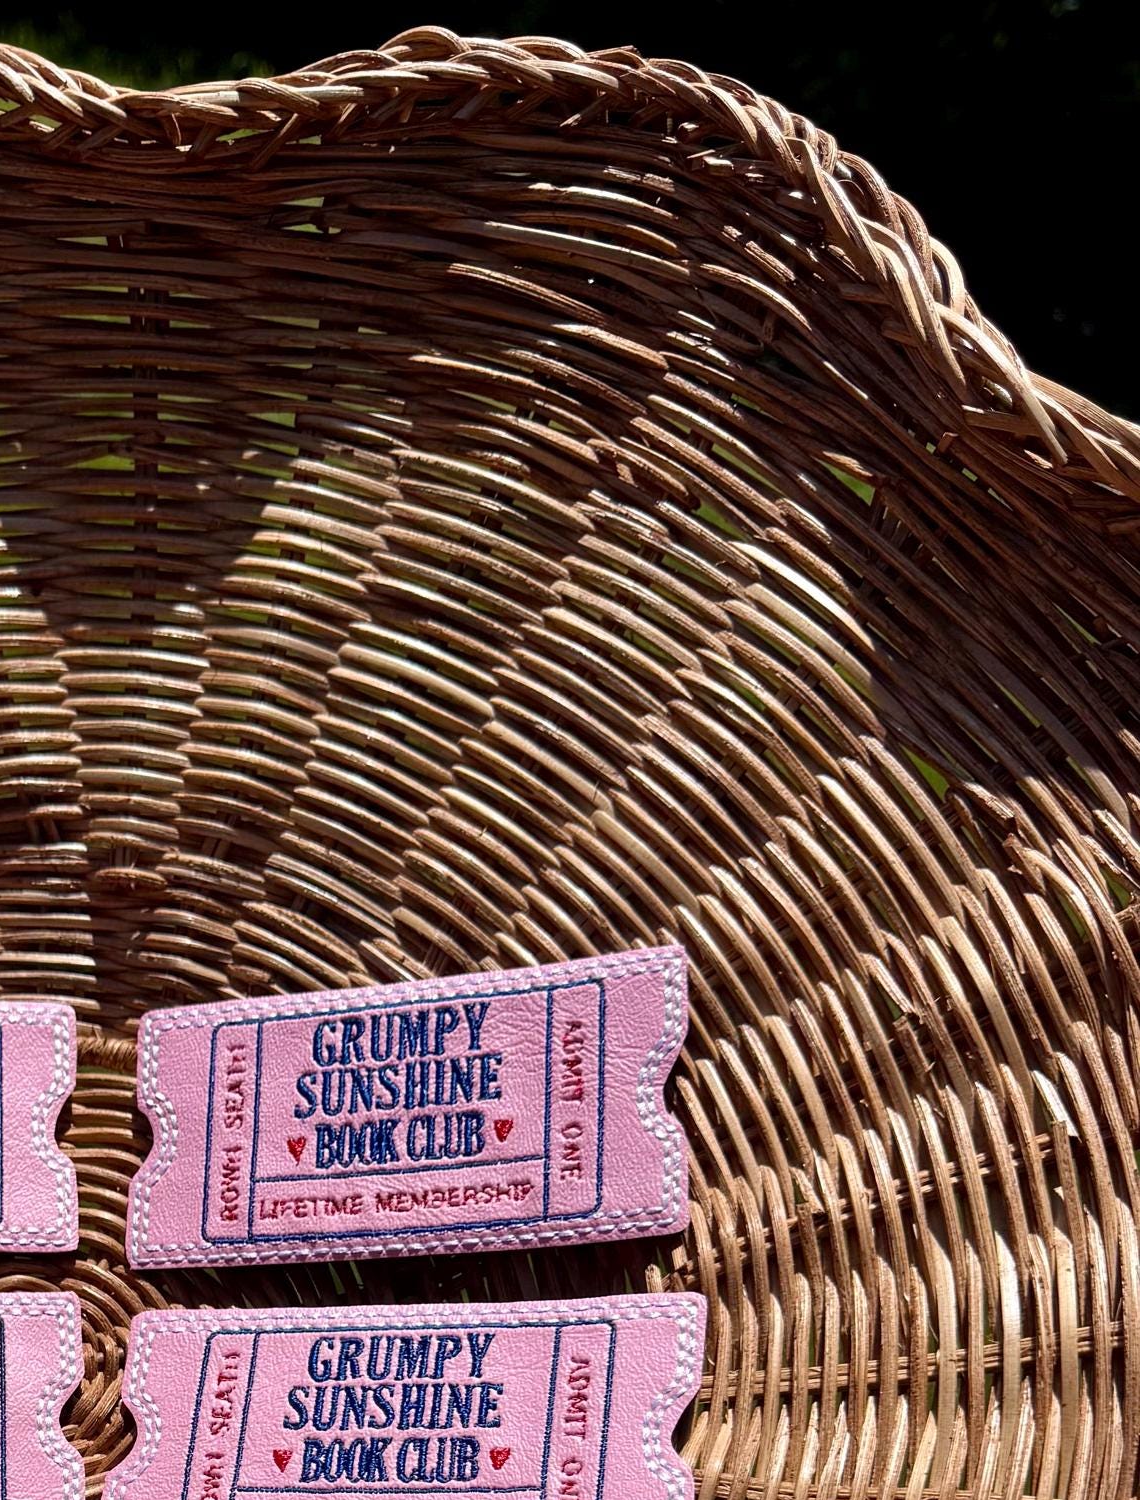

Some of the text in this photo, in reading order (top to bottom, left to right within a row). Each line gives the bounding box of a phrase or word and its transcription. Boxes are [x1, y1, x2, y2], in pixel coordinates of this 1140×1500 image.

[312, 1001, 490, 1067] GRUMPY
[293, 1053, 503, 1119] SUNSHINE
[560, 1019, 584, 1181] ADMIT ONE
[315, 1111, 488, 1169] BOOK CLUB
[260, 1179, 534, 1221] LIFETIME MEMBERSHIP
[308, 1333, 496, 1382] GRUMPY
[283, 1383, 504, 1431] SUNSHINE
[563, 1355, 591, 1442] ADMIT
[299, 1436, 481, 1484] BOOK CLUB
